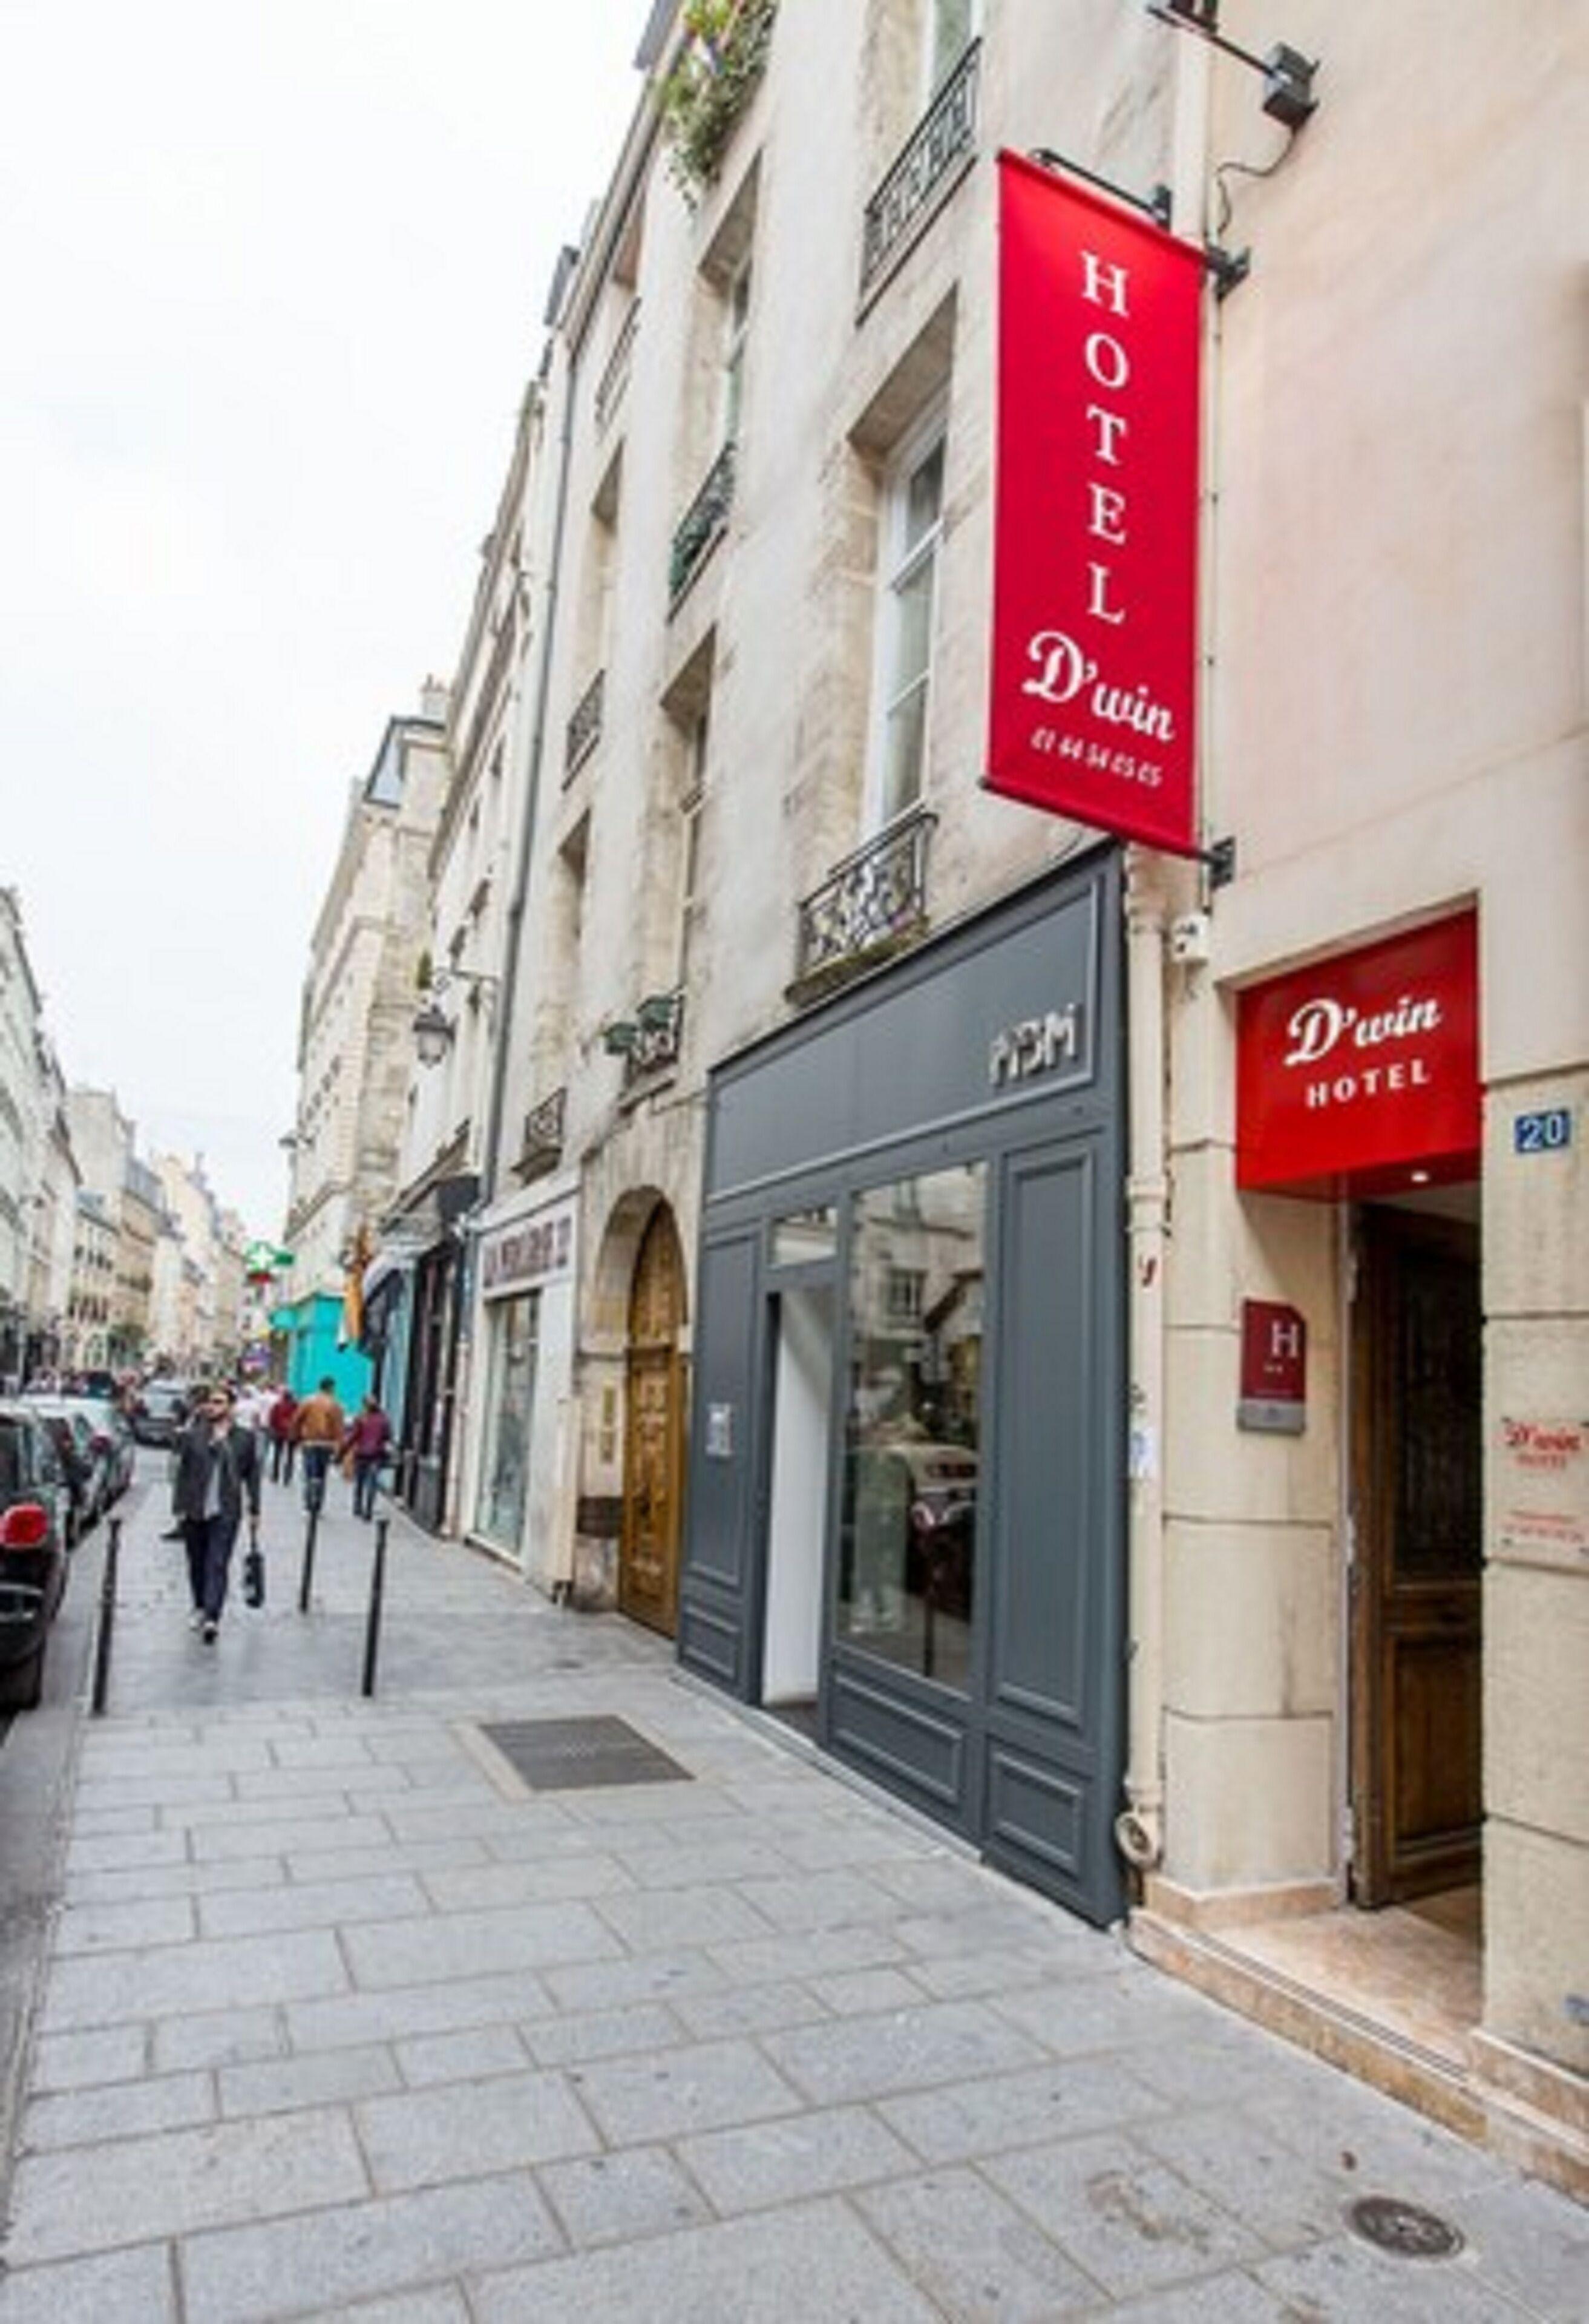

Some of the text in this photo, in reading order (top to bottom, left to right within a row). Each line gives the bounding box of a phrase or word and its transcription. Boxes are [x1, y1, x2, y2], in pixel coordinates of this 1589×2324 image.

[1081, 250, 1130, 626] HOTEL
[1023, 631, 1176, 742] D'win
[1283, 996, 1441, 1067] D'win
[1307, 1059, 1430, 1109] HOTEL
[1521, 1114, 1566, 1149] 20
[1272, 1319, 1298, 1358] H
